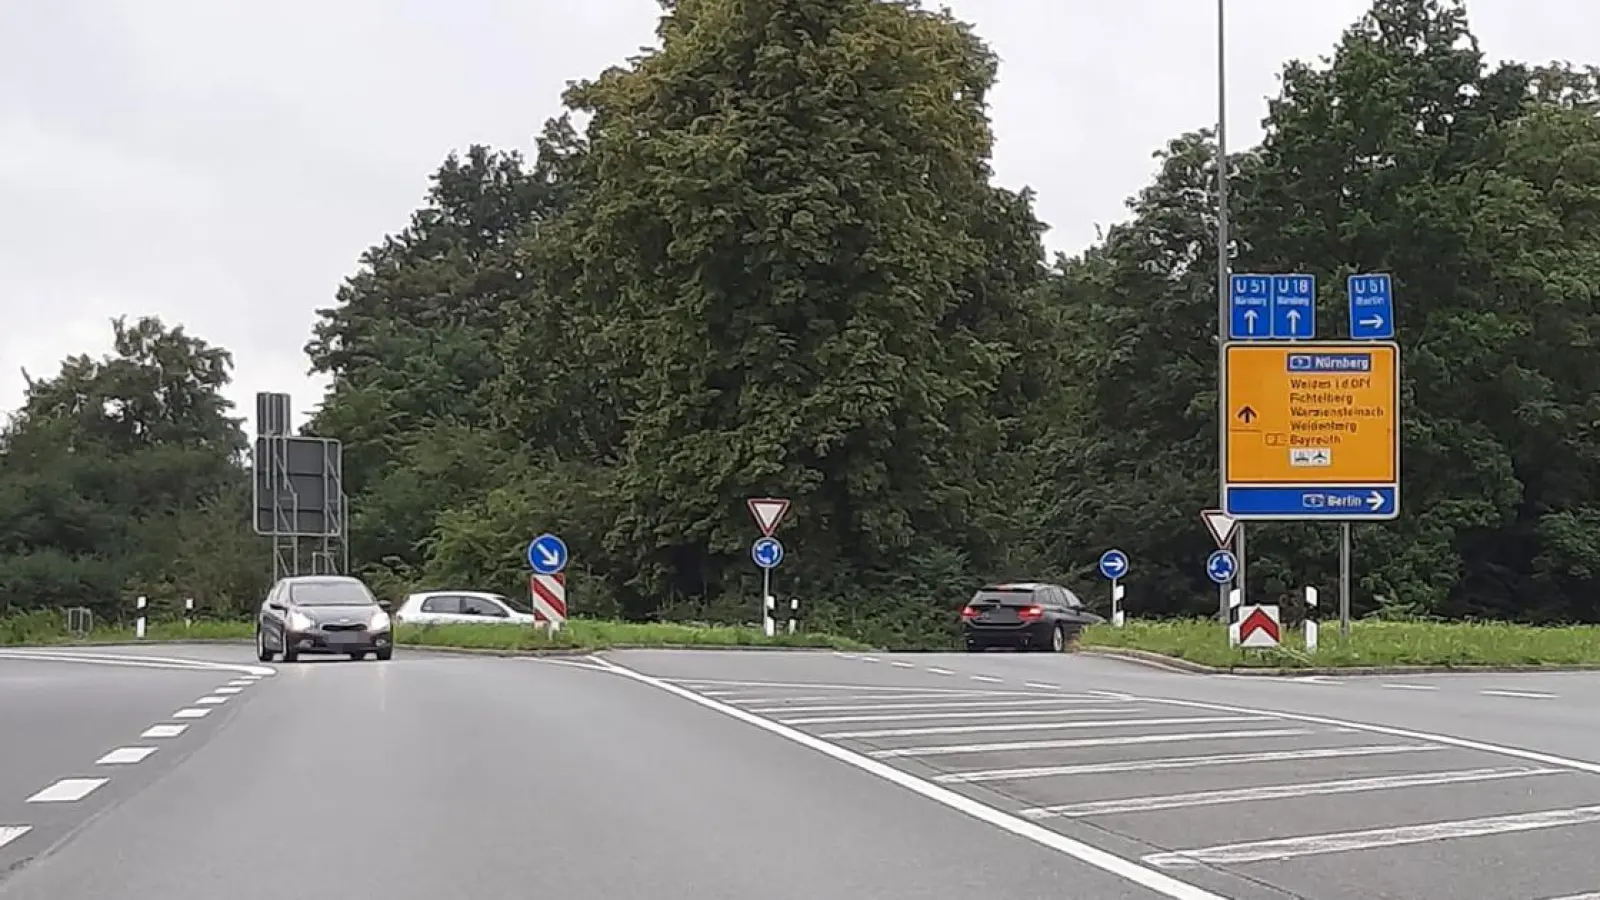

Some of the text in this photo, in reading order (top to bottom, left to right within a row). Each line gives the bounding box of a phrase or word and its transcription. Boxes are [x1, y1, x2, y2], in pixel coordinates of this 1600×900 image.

[1236, 279, 1267, 294] U 51
[1278, 279, 1309, 294] U 18
[1355, 278, 1384, 294] U 51
[1315, 356, 1369, 370] Nürnberg
[1328, 495, 1362, 507] Berlin
